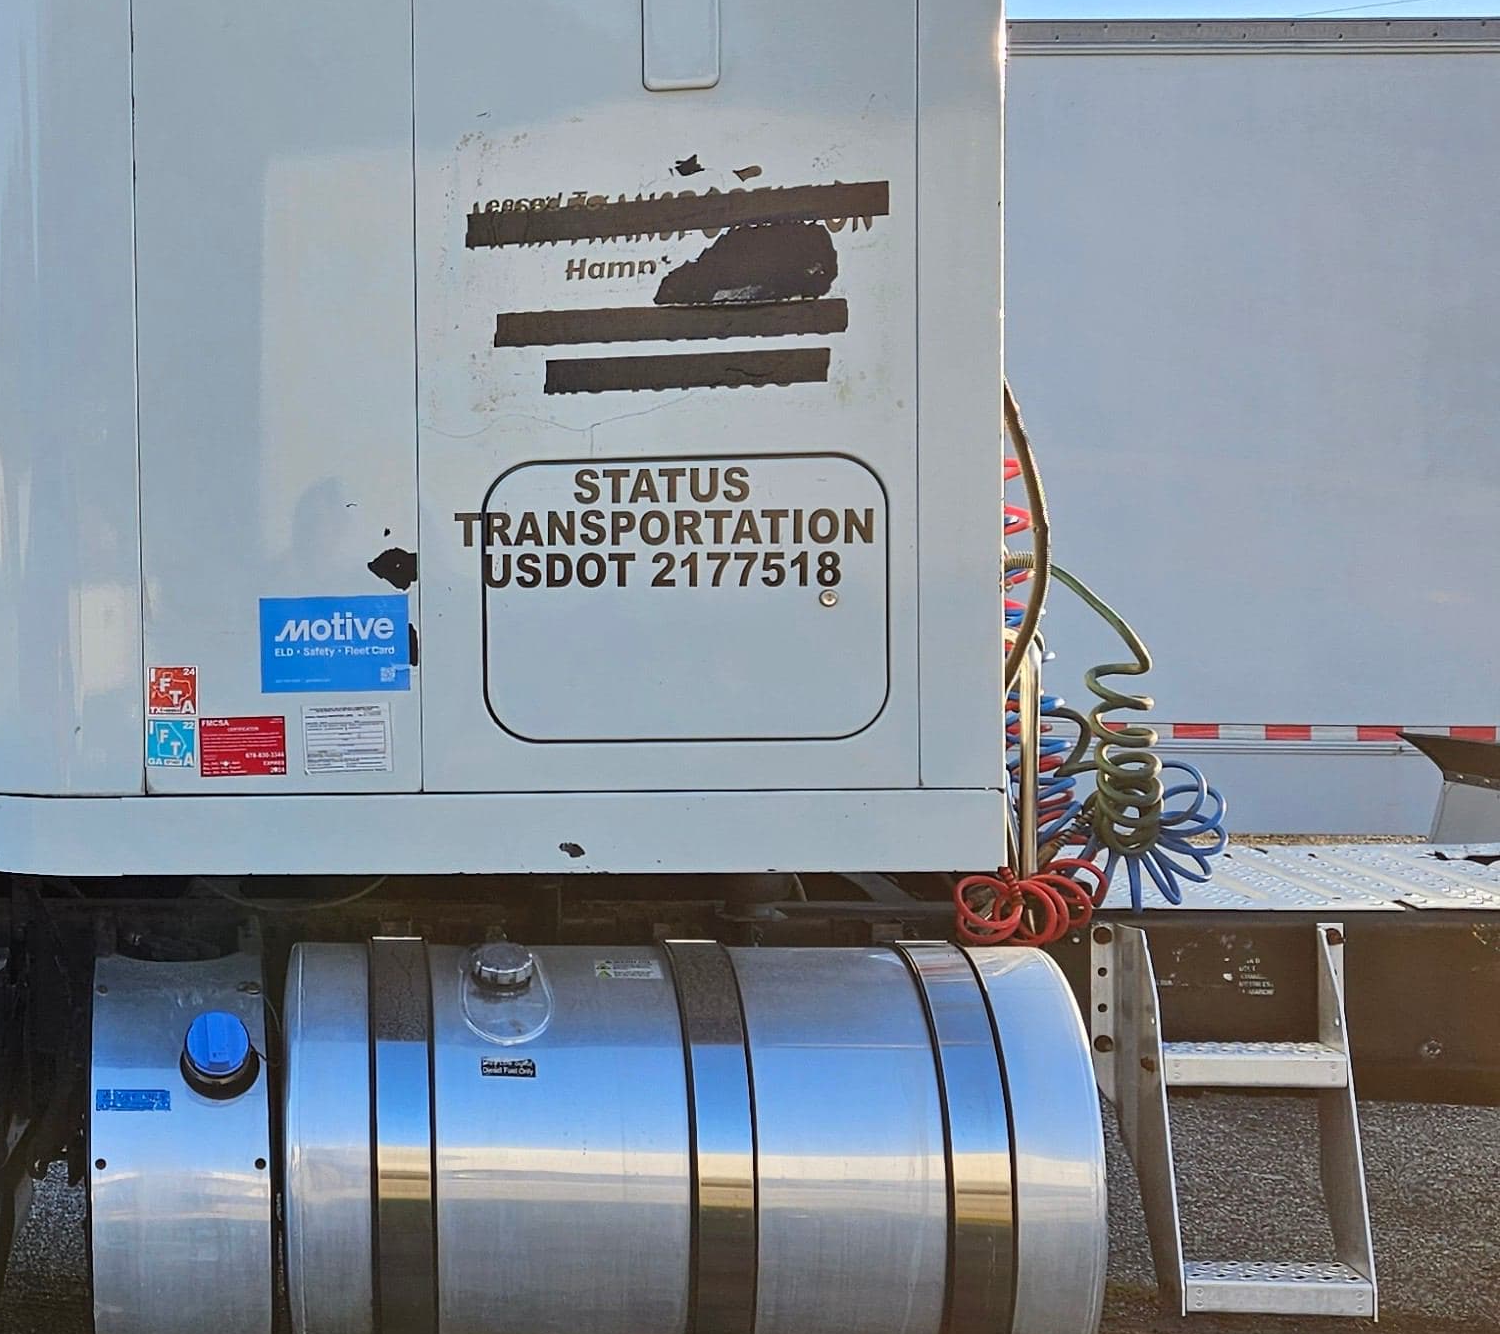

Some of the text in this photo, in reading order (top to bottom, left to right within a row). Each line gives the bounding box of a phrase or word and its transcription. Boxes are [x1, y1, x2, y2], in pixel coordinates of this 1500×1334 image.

[573, 466, 750, 504] STATUS
[454, 508, 875, 547] TRANSPORTATION
[484, 550, 842, 589] USDOT 2177518
[274, 645, 395, 658] ELD Safety Fleet Card
[182, 668, 196, 676] 24
[150, 706, 162, 714] TX
[182, 722, 195, 730] 22
[147, 758, 162, 766] GA
